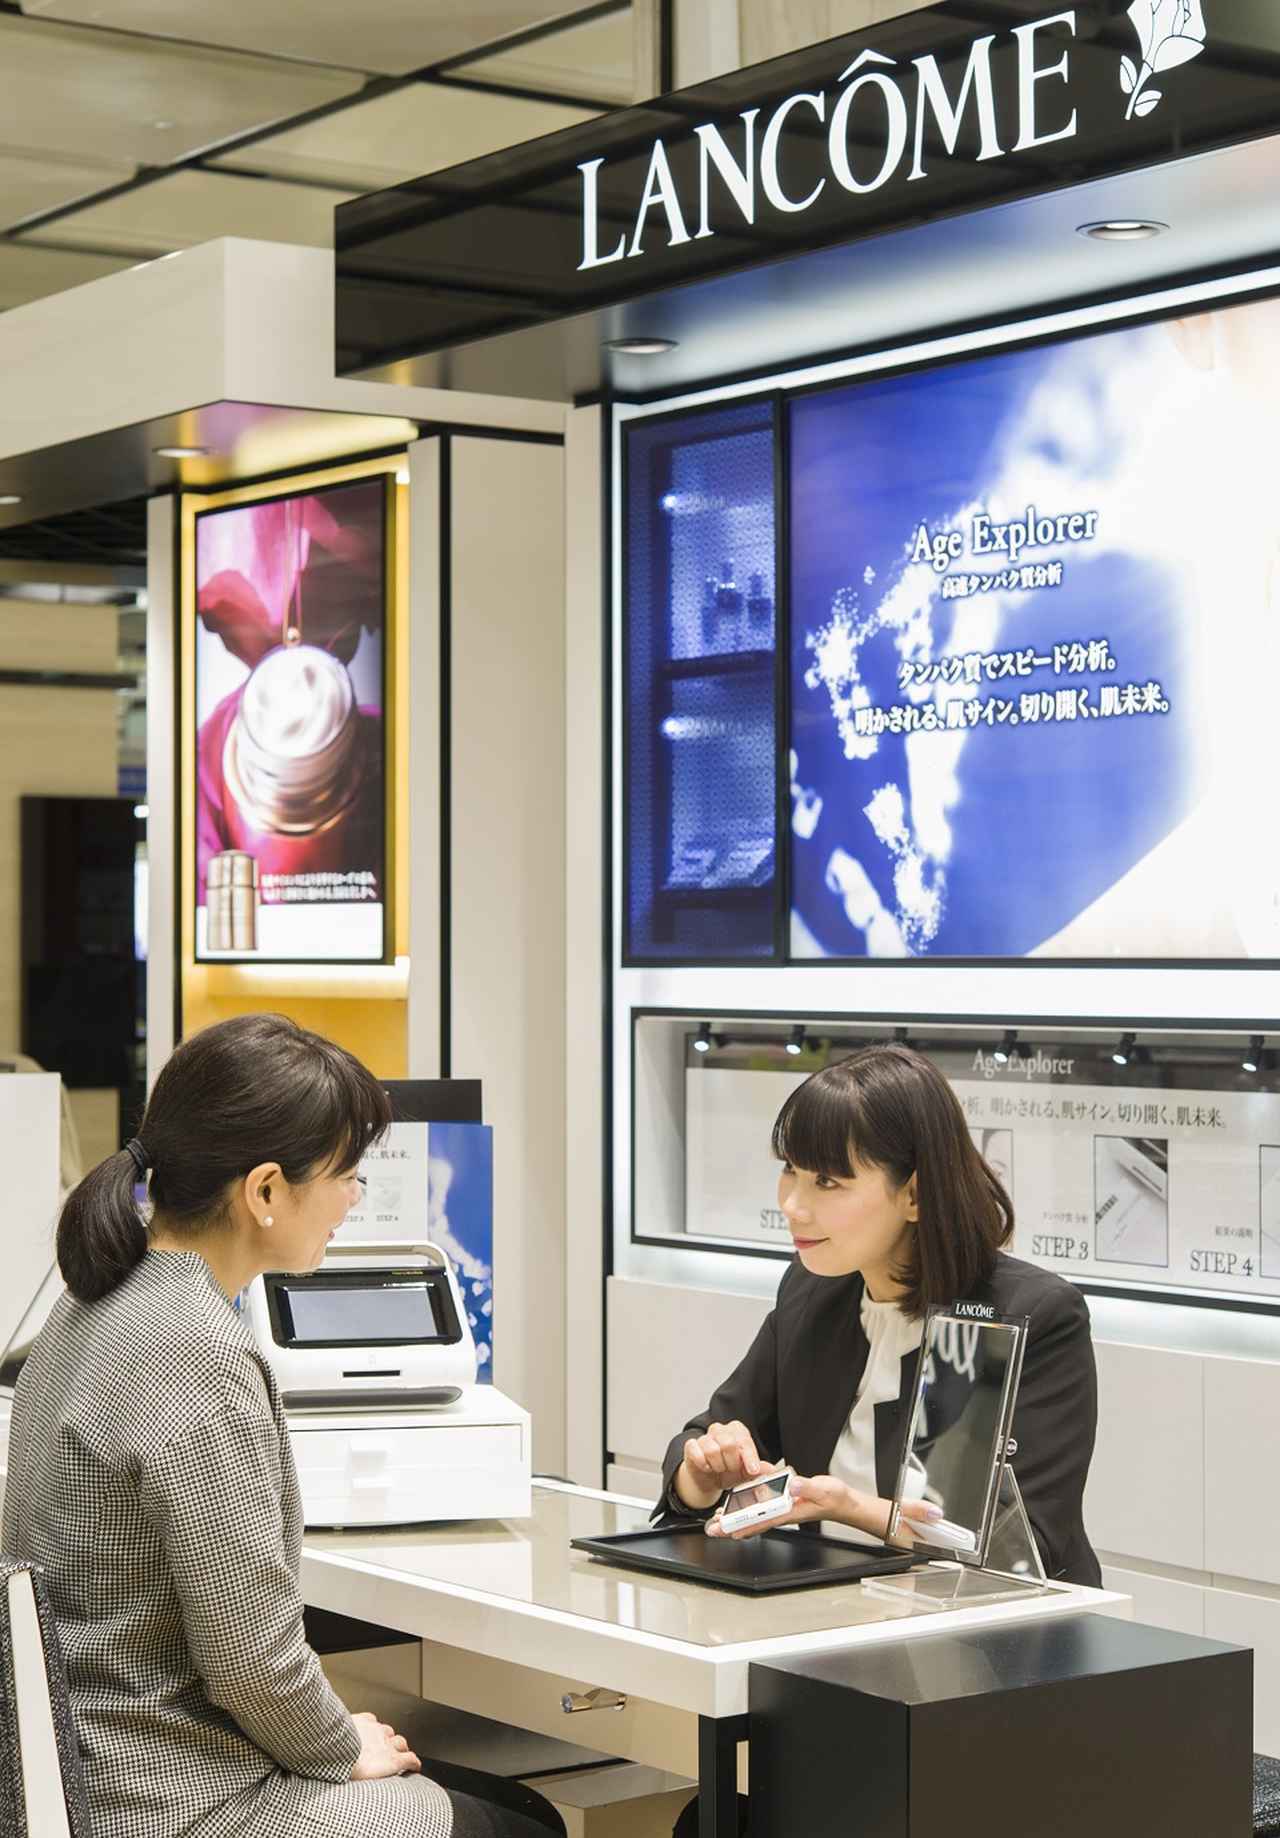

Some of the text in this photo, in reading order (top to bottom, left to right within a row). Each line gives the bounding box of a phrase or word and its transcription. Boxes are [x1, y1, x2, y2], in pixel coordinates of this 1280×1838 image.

[577, 10, 1077, 271] LANCÔME
[911, 505, 1098, 572] Age Explorer
[899, 640, 1116, 688] タンパク質でスピード分析。
[1032, 1234, 1089, 1260] STEP 3
[1190, 1249, 1253, 1276] STEP 4
[955, 1303, 995, 1319] LANCÔME
